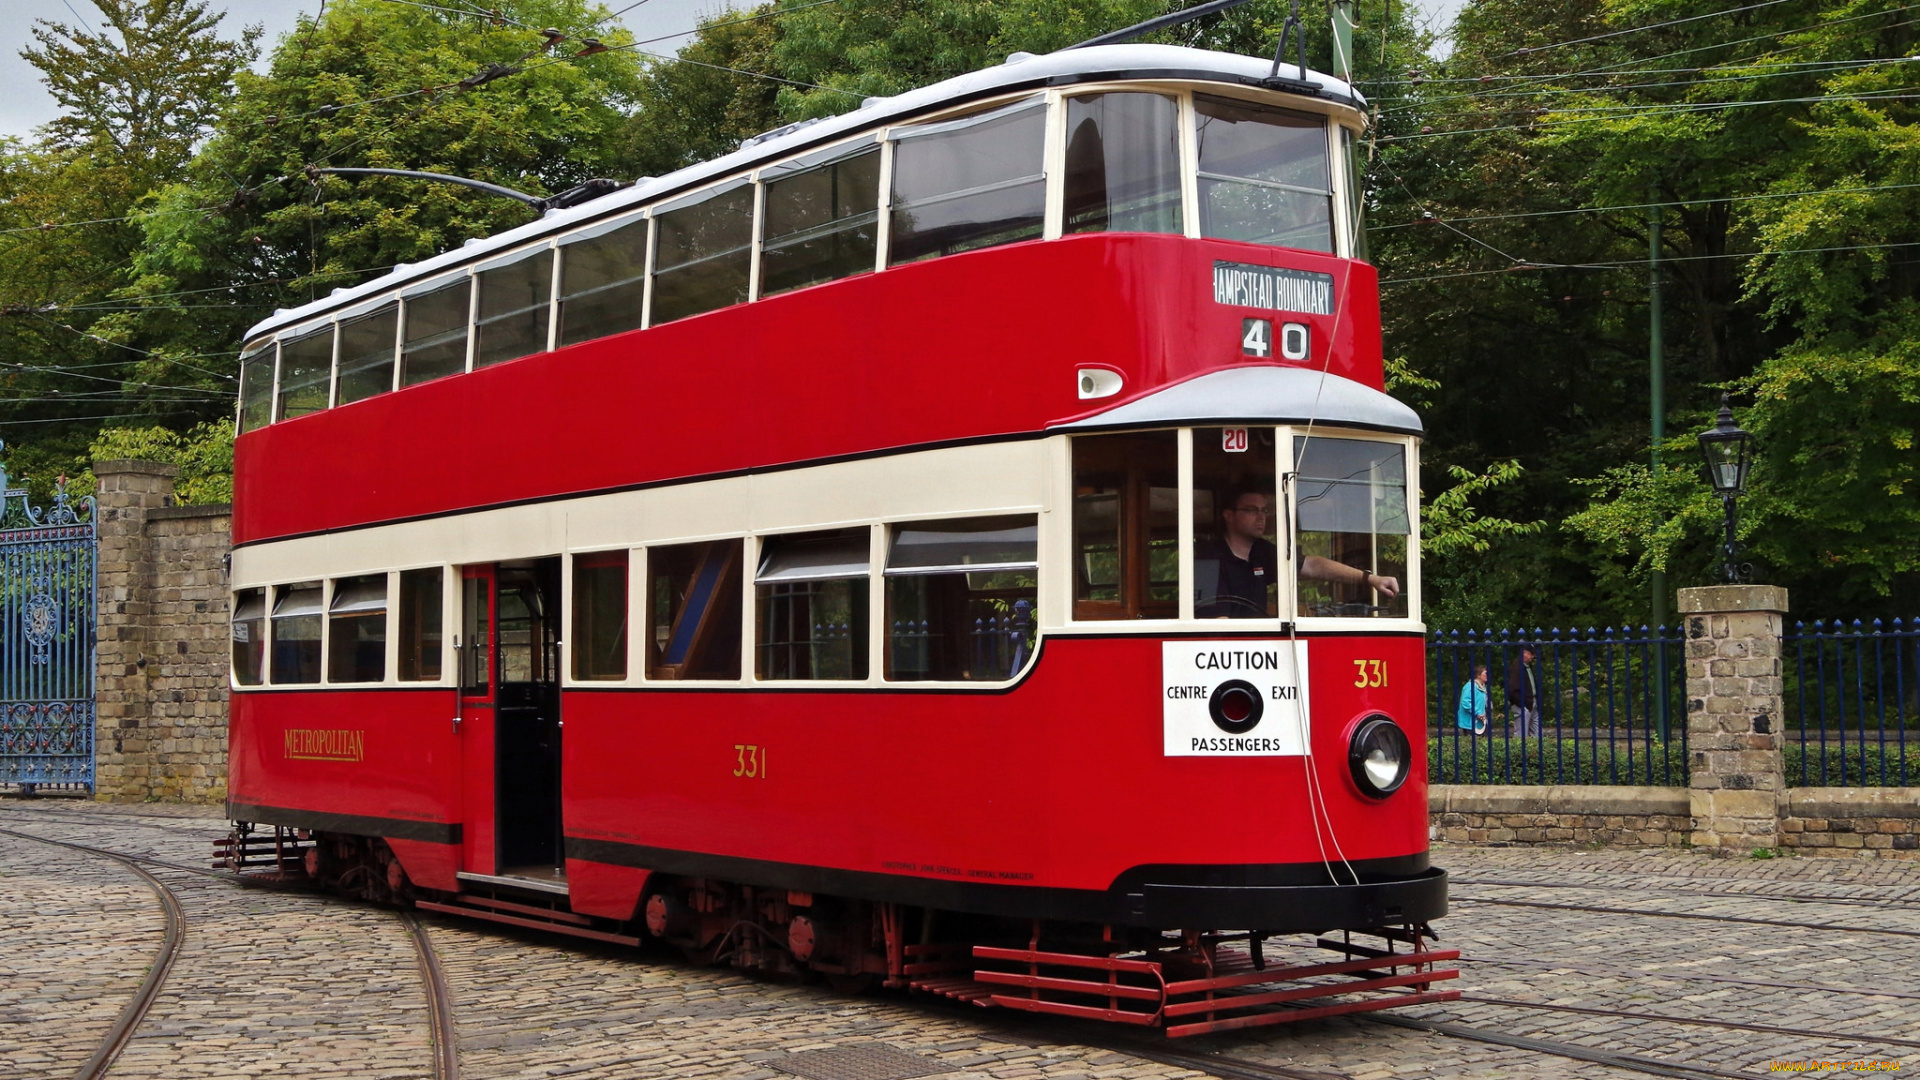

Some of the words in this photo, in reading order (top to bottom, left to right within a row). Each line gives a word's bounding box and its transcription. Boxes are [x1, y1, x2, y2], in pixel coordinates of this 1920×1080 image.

[1276, 275, 1330, 315] BOUNDARY
[1224, 428, 1246, 450] 20
[1195, 651, 1278, 670] CAUTION
[1353, 659, 1389, 689] 331
[1167, 685, 1208, 700] CENTRE
[1271, 685, 1298, 700] EXIT
[283, 729, 365, 762] METROPOLITAN
[1191, 737, 1281, 752] PASSENGERS
[732, 744, 767, 779] 331
[967, 869, 997, 879] GENERAL
[998, 871, 1035, 881] MANAGER
